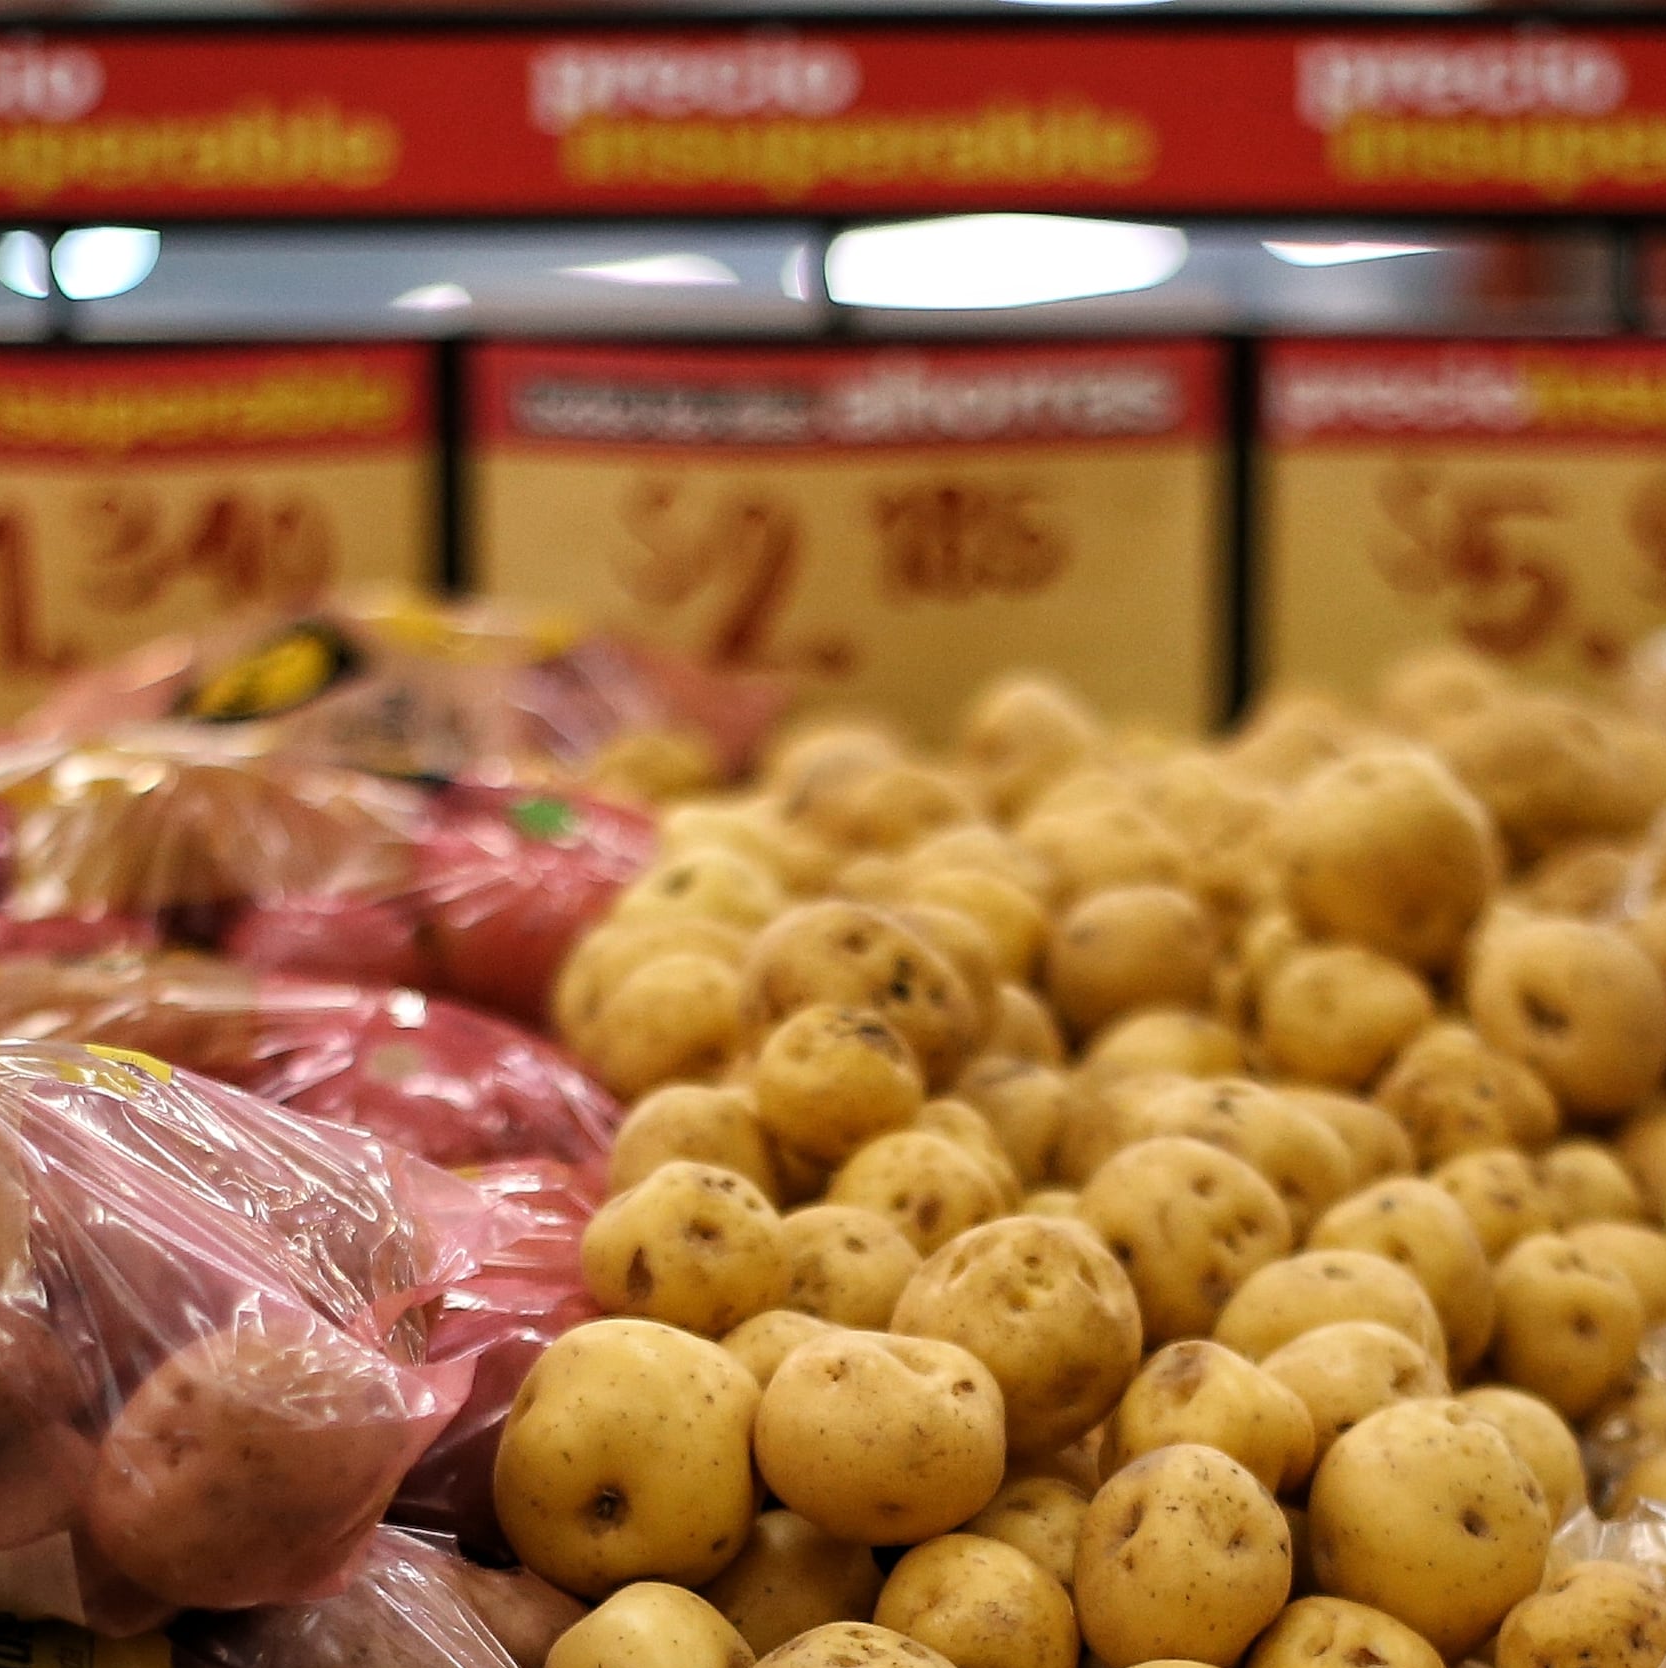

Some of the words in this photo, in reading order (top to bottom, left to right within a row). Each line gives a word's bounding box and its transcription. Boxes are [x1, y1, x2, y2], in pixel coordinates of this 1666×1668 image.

[533, 38, 859, 130] precio
[1298, 35, 1625, 130] precio
[565, 96, 1153, 194] insuperable
